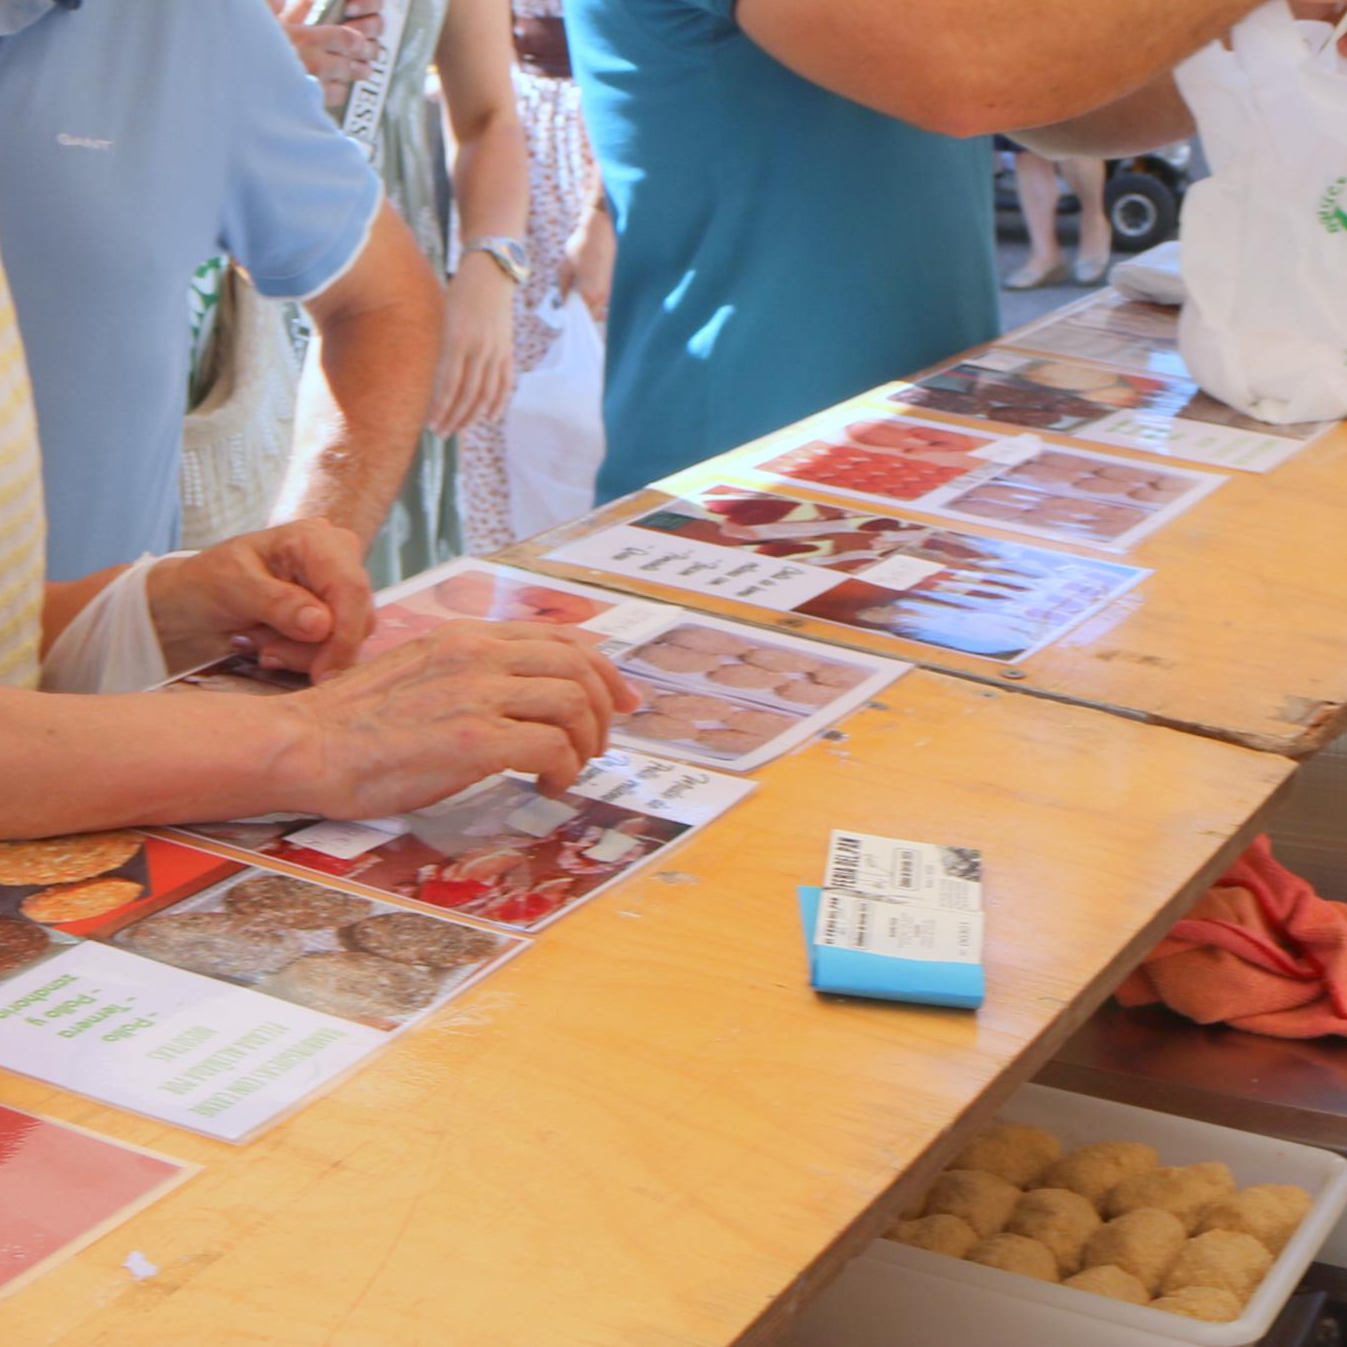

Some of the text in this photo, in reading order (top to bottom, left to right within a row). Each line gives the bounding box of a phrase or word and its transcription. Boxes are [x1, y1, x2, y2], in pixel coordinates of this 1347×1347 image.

[24, 994, 95, 1026] Pollo y
[57, 1005, 129, 1038] Ternera
[100, 1017, 154, 1042] Pollo
